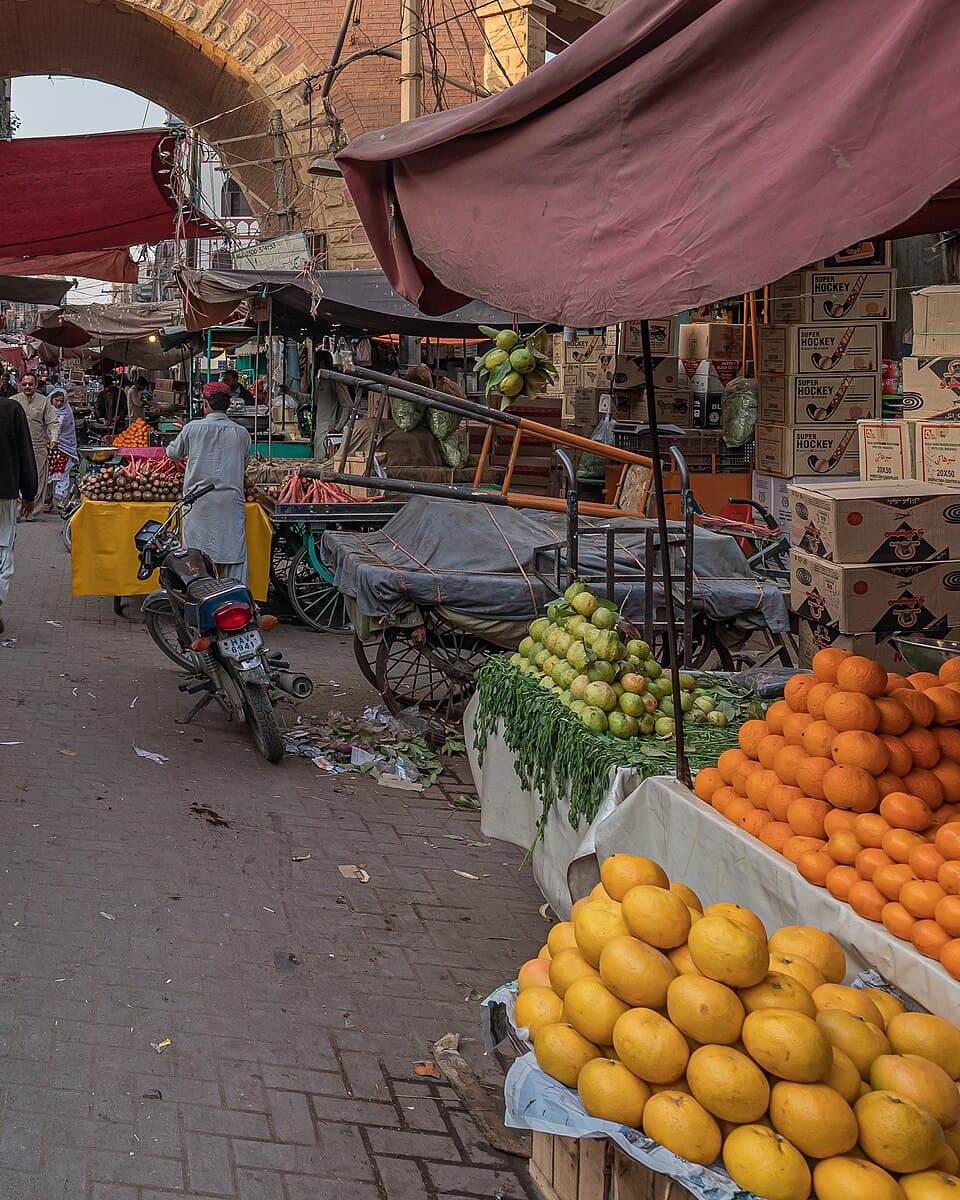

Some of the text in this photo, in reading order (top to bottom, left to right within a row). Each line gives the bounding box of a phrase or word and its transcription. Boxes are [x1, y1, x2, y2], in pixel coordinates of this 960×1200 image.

[815, 282, 850, 292] HOCKEY
[801, 337, 835, 347] HOCKEY
[797, 386, 834, 396] HOCKEY
[796, 440, 834, 449] HOCKEY
[936, 469, 955, 478] 20X50
[230, 634, 250, 647] HAV
[231, 641, 255, 653] 6941
